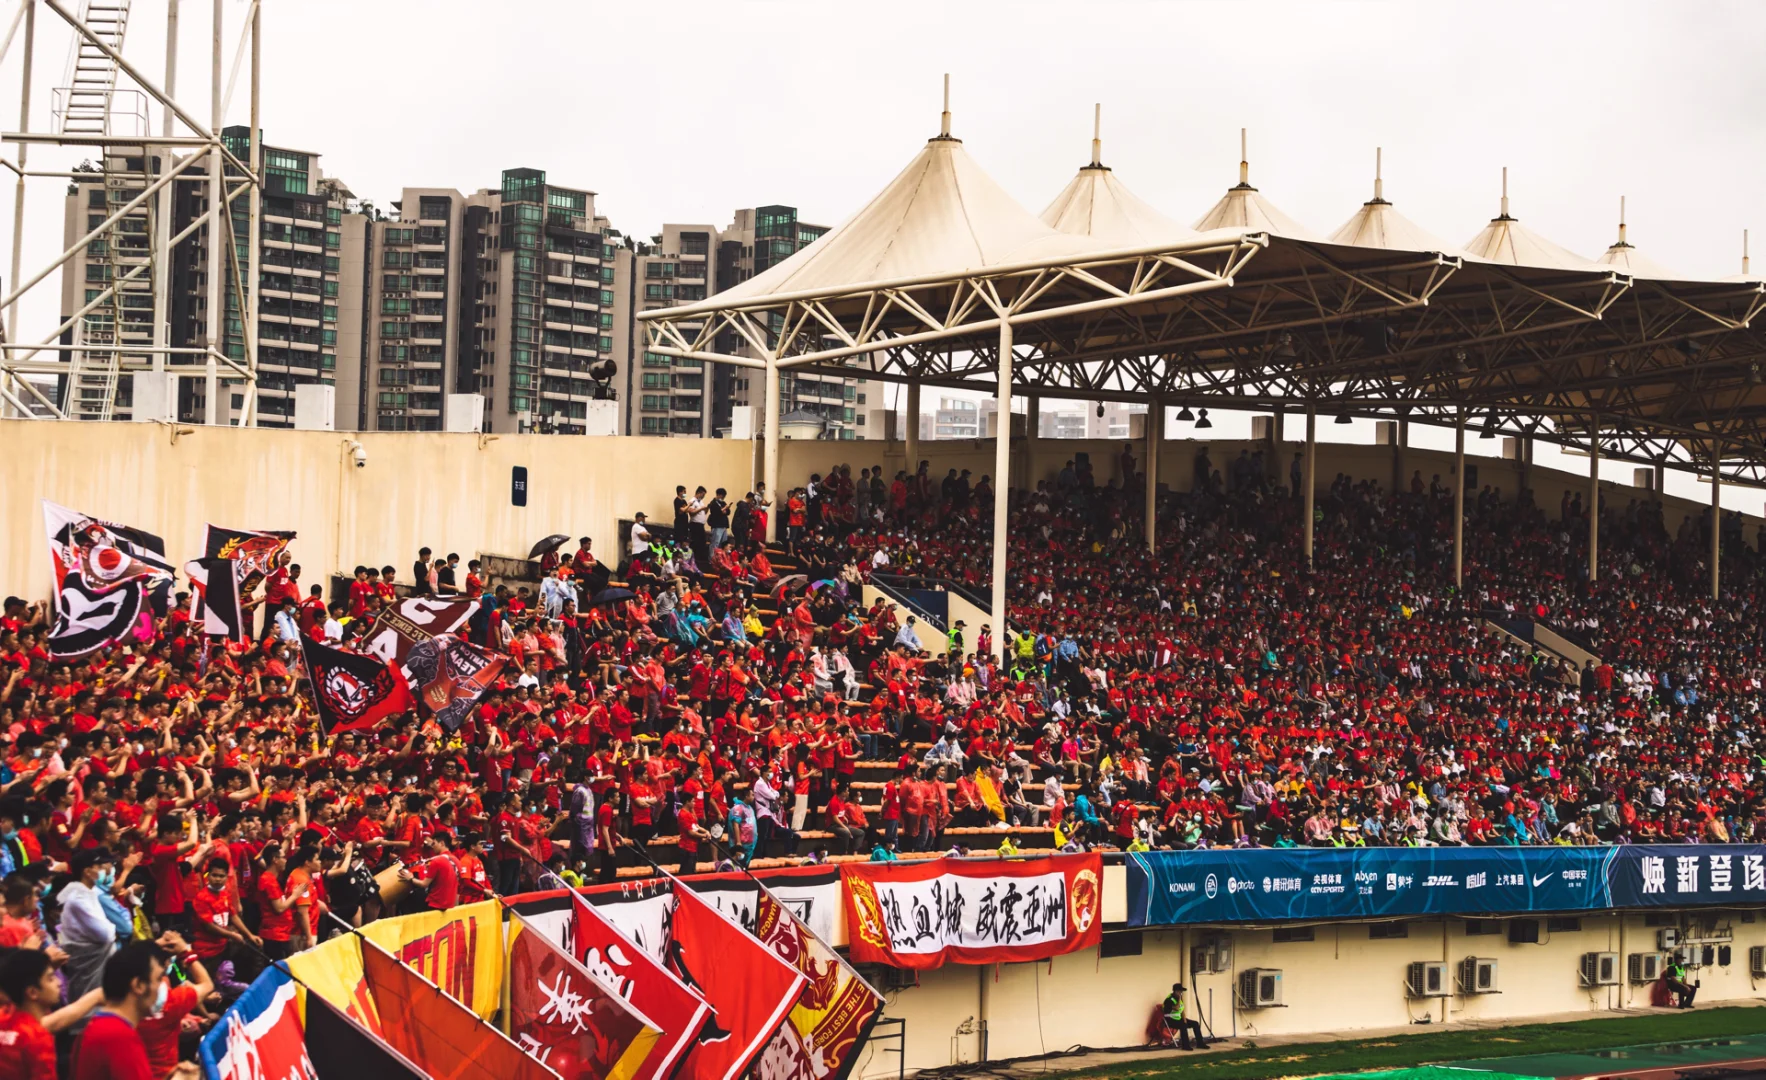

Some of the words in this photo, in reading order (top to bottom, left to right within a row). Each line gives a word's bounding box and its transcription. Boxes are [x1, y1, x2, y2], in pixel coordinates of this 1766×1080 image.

[1313, 874, 1342, 885] 央视体育
[1354, 871, 1378, 884] Absen
[1495, 874, 1524, 886] 上汽集团
[1562, 870, 1587, 880] 中国平安
[1641, 855, 1765, 893] 焕新登场
[1169, 882, 1196, 893] KONAMI
[1272, 878, 1302, 892] 腾讯体育
[1427, 875, 1453, 887] DHL
[976, 879, 1066, 944] 威震亚洲
[846, 993, 861, 1012] THE
[831, 1010, 849, 1031] BEST
